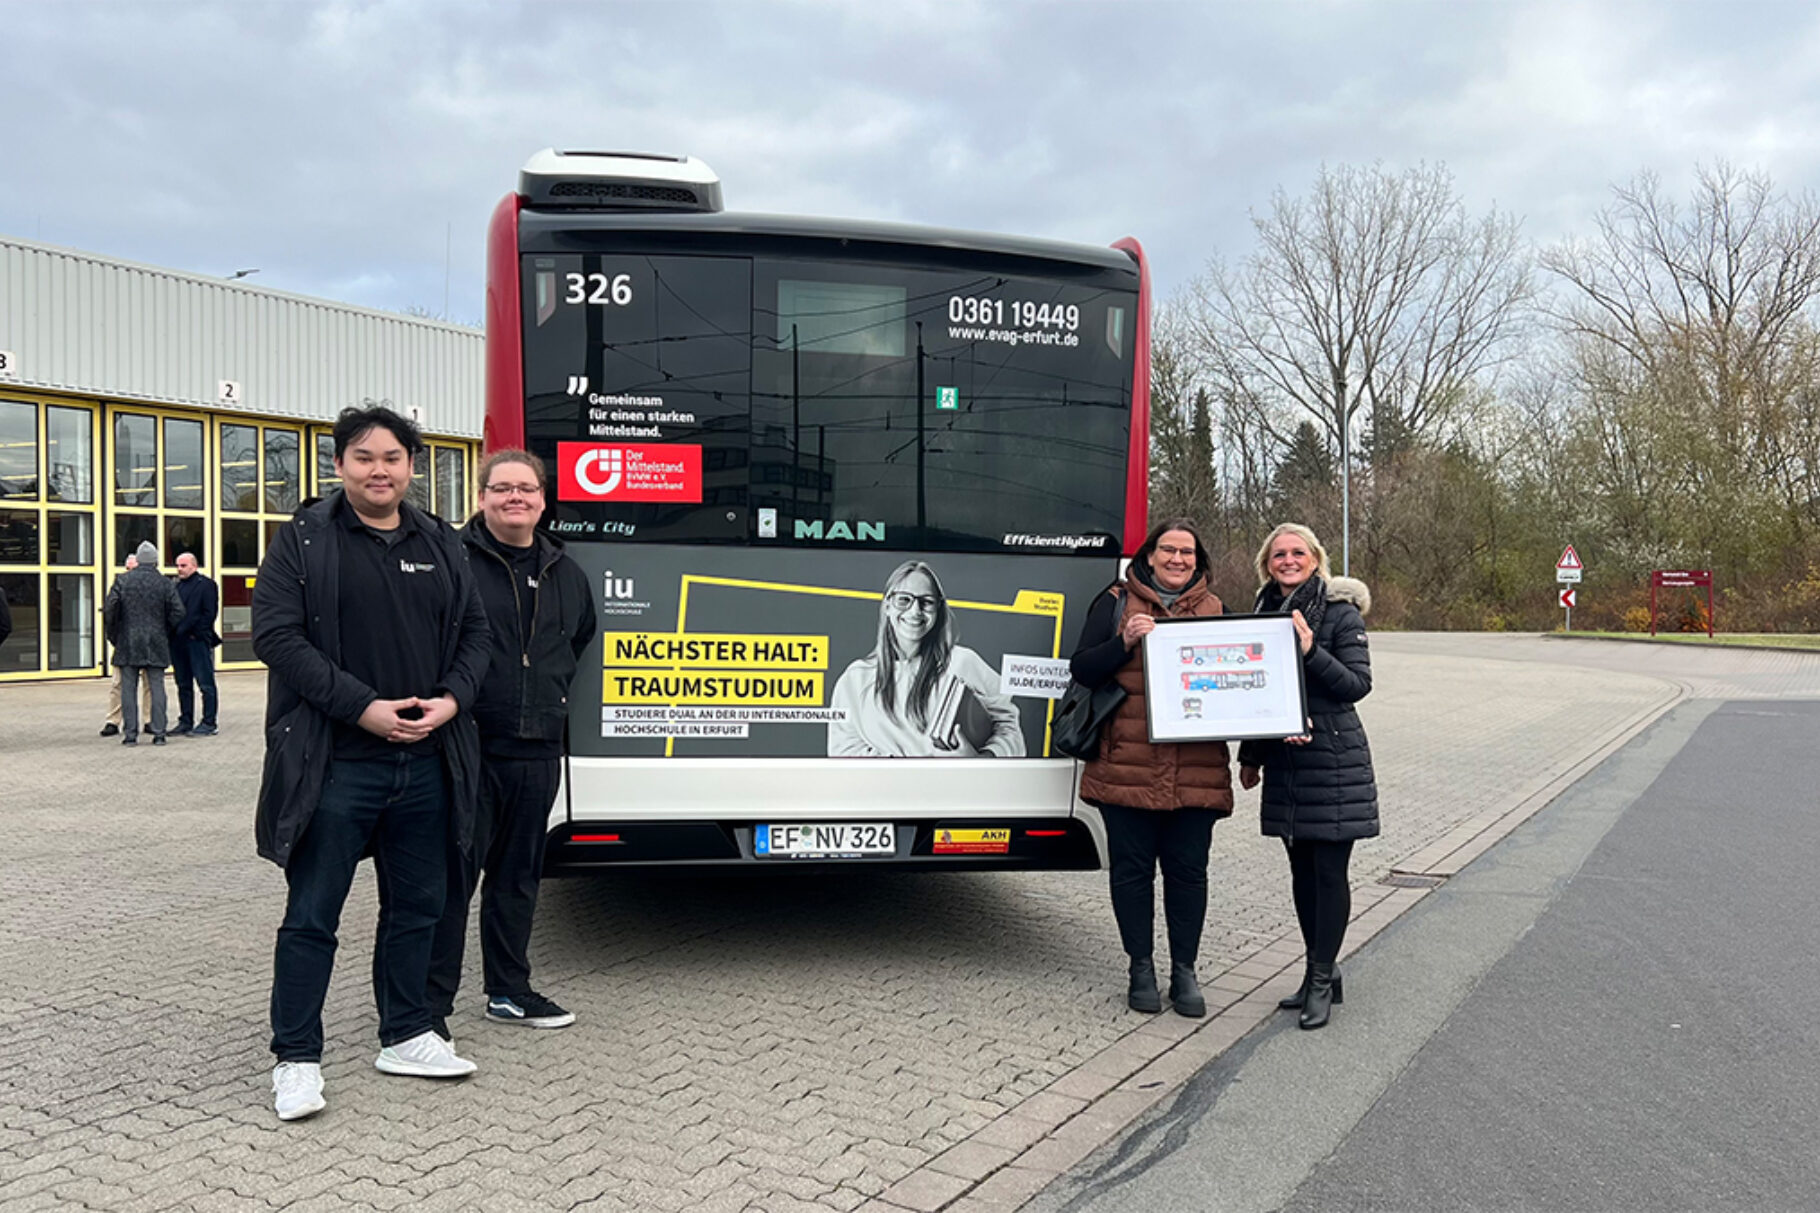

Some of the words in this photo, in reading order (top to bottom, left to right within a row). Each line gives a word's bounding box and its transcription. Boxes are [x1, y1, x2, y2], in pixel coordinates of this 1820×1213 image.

[565, 273, 632, 305] 326
[949, 296, 1003, 325] 0361
[1011, 301, 1080, 331] 19449
[949, 327, 1079, 346] www.evag-erfurt.de
[225, 383, 233, 398] 2
[588, 393, 663, 407] Gemeinsam
[588, 407, 608, 420] für
[610, 408, 645, 421] einen
[647, 410, 695, 423] starken
[589, 423, 662, 437] Mittelstand.
[626, 449, 643, 460] Der
[549, 520, 596, 532] Lion's
[602, 521, 636, 536] City
[794, 519, 885, 541] MAN
[1003, 533, 1107, 549] EfficientHybrid
[604, 570, 634, 599] iu
[615, 634, 747, 661] NÄCHSTER
[753, 642, 818, 662] HALT:
[1010, 664, 1038, 675] INFOS
[1039, 665, 1070, 678] UNTER
[614, 677, 814, 699] TRAUMSTUDIUM
[1009, 677, 1070, 690] IU.DE/ERFUR
[614, 709, 667, 719] STUDIERE
[669, 709, 696, 719] DUAL
[699, 709, 713, 719] AN
[716, 710, 737, 719] DER
[739, 710, 749, 719] IU
[751, 710, 846, 721] INTERNATIONALEN
[614, 725, 687, 735] HOCHSCHULE
[689, 726, 700, 735] IN
[702, 726, 743, 735] ERFURT
[771, 827, 799, 849] EF
[816, 827, 844, 849] NV
[850, 826, 891, 849] 326
[982, 831, 1007, 840] AKH
